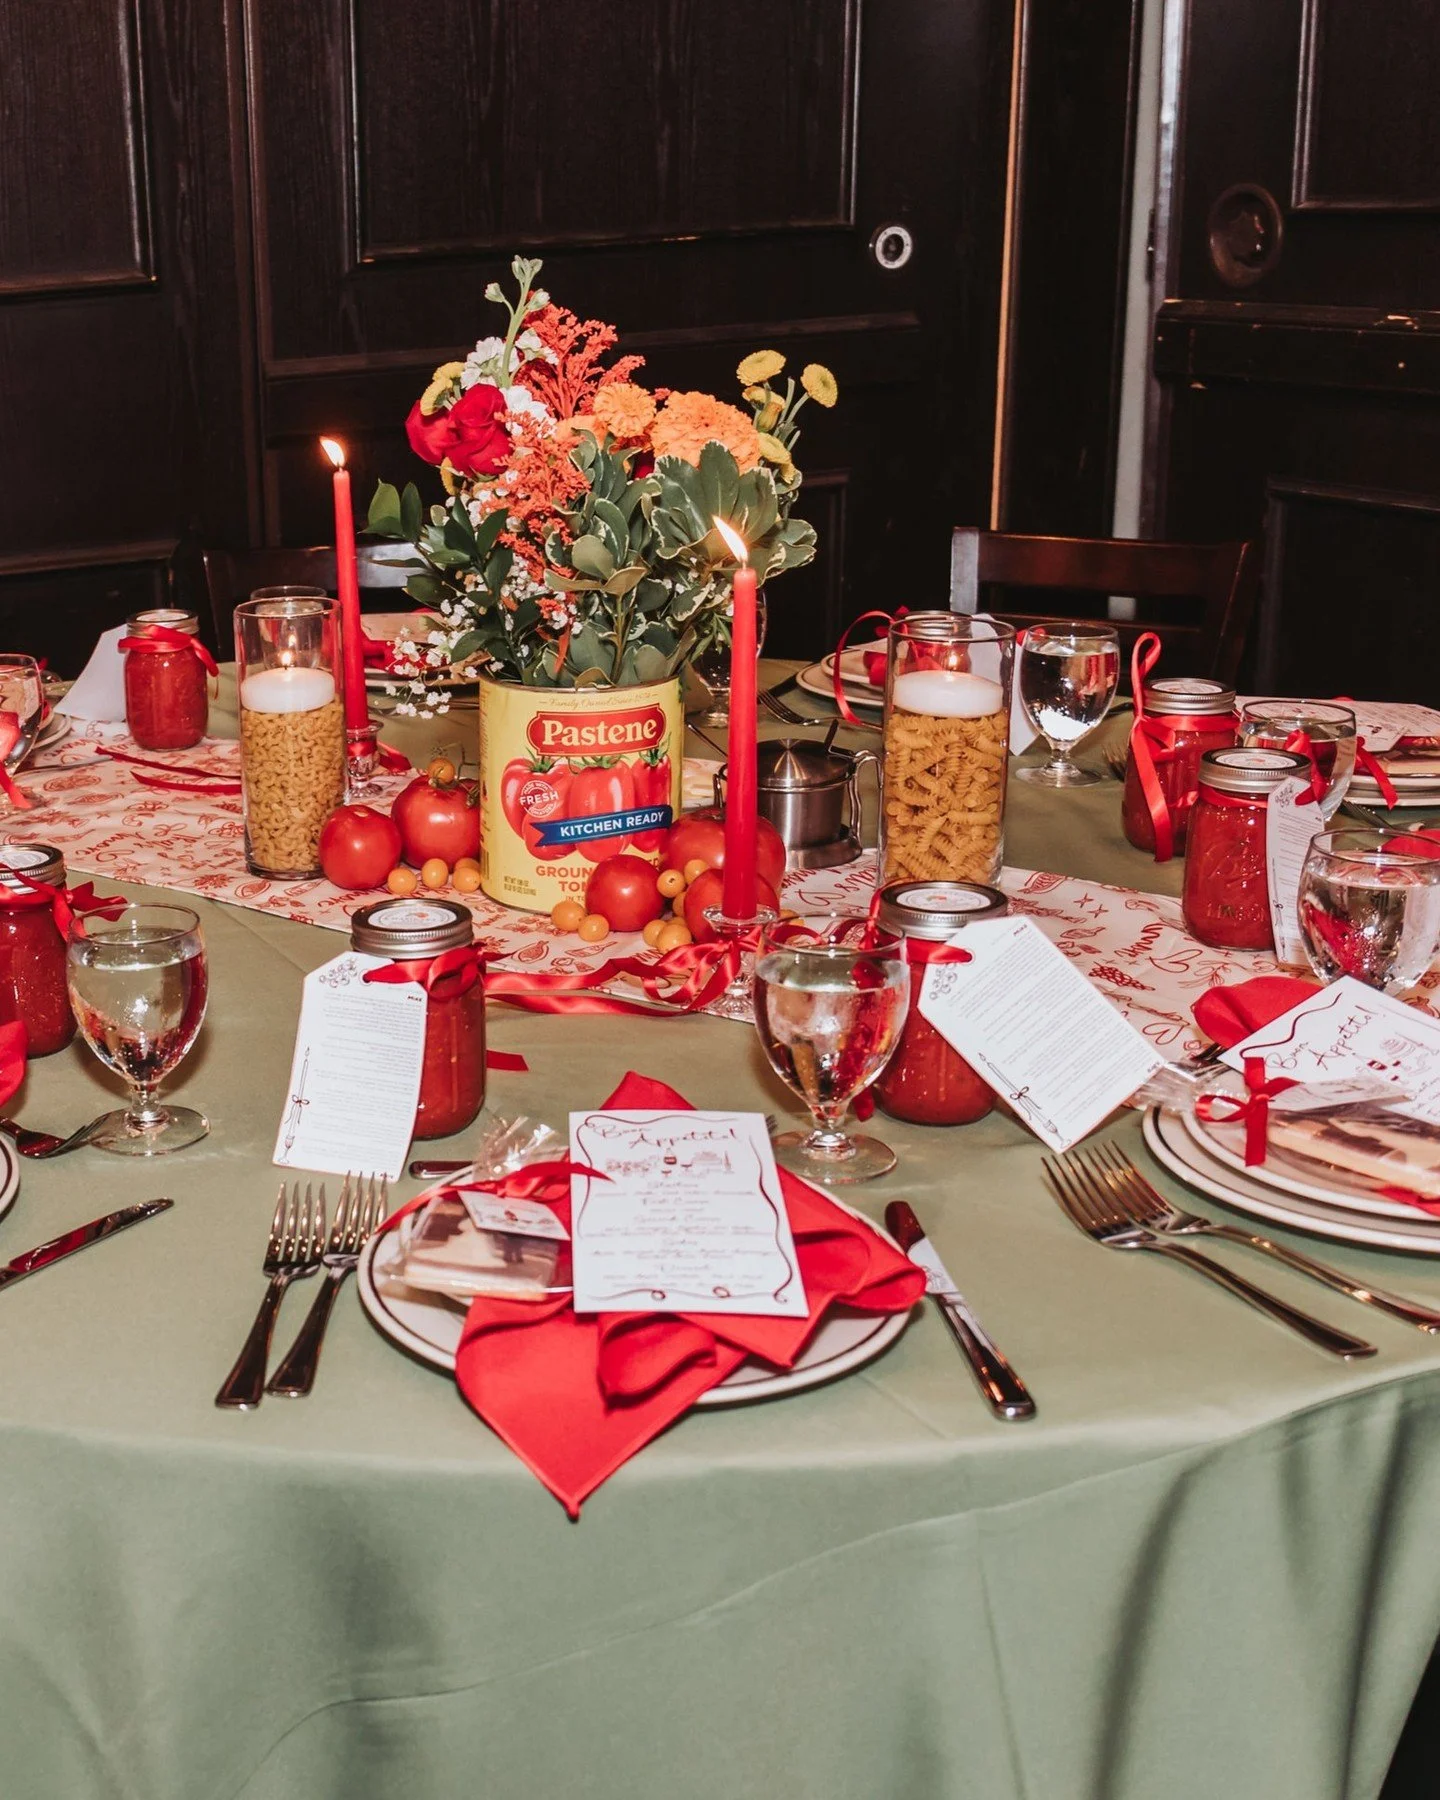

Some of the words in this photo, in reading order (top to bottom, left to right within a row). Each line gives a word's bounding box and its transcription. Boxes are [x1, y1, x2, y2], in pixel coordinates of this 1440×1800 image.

[542, 717, 657, 746] Pastene
[520, 790, 559, 805] FRESH
[560, 818, 622, 837] KITCHEN
[625, 811, 665, 830] READY
[536, 865, 592, 878] GROUN
[1266, 1040, 1309, 1072] Buon
